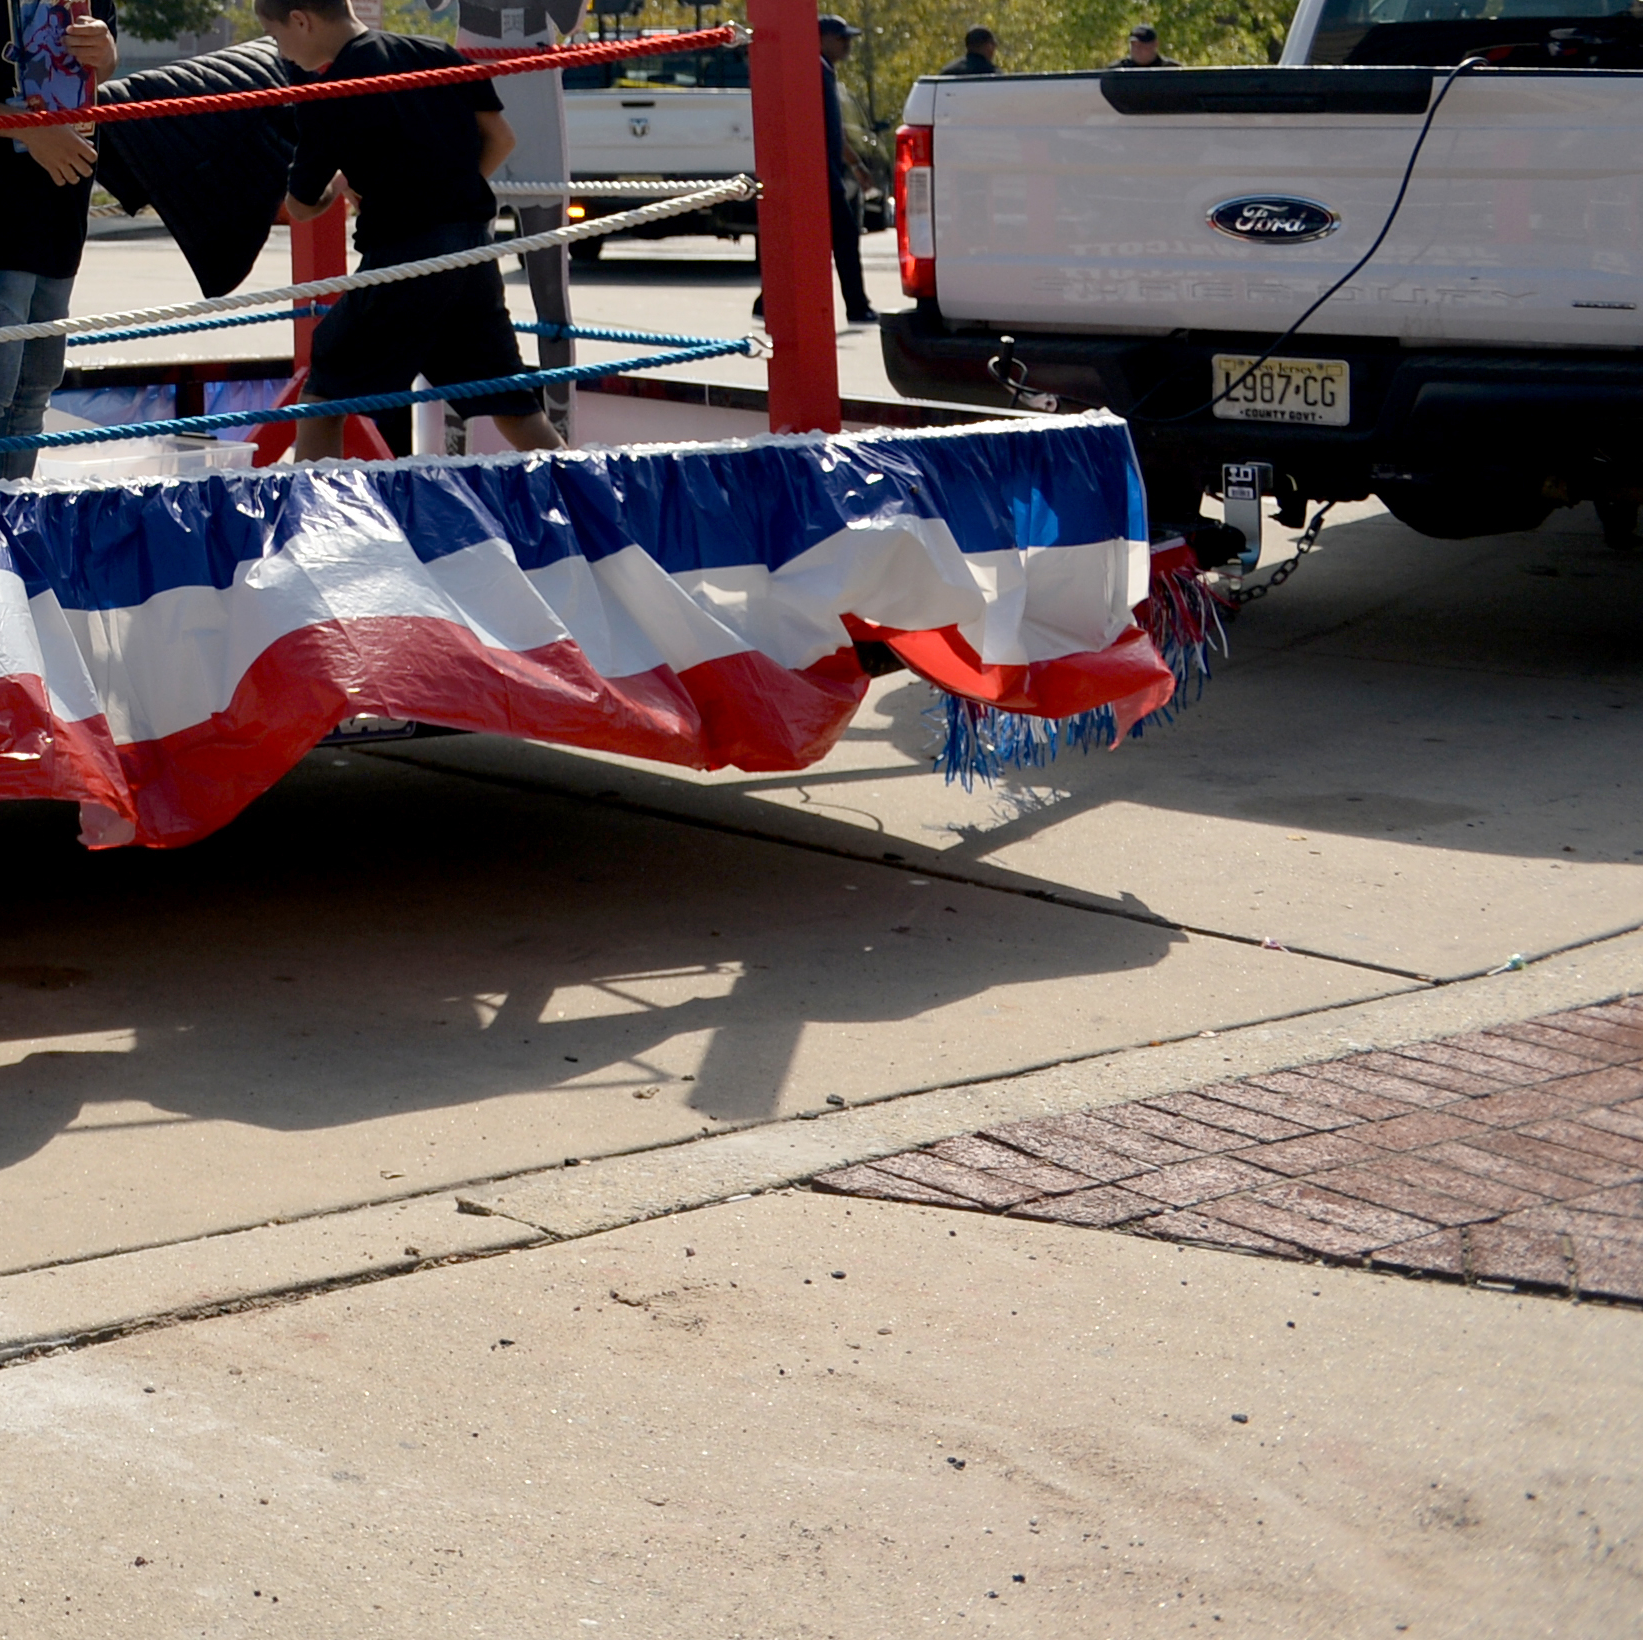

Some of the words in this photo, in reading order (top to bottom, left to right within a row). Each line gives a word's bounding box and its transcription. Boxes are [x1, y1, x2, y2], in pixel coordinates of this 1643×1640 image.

[1234, 203, 1307, 235] Ford
[1278, 362, 1314, 375] Jersey
[1245, 408, 1286, 419] COUNTY
[1289, 411, 1317, 422] GOVT
